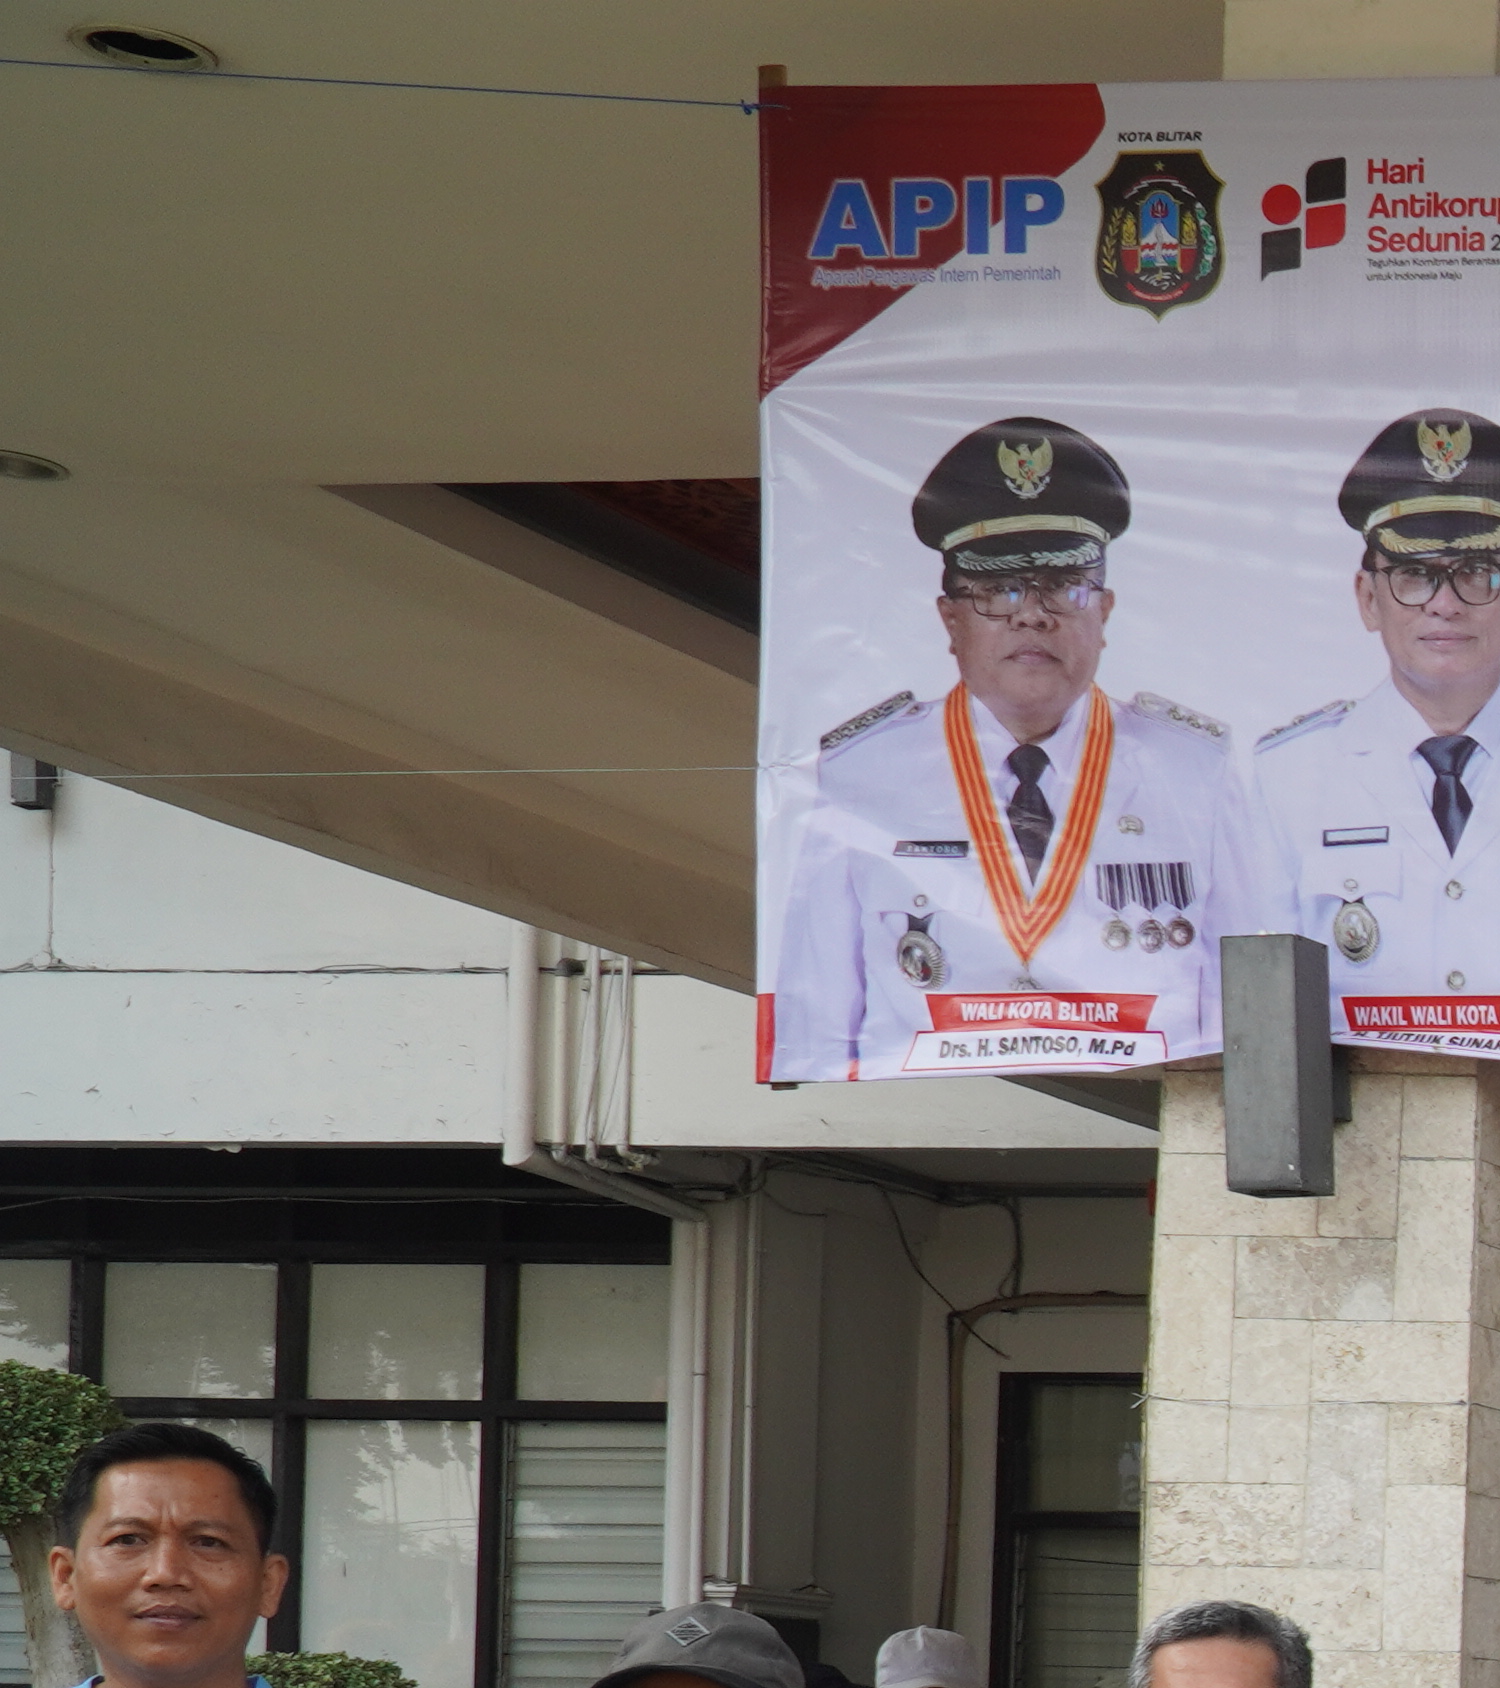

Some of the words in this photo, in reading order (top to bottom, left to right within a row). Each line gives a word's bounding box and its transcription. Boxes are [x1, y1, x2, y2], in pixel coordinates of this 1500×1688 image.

[1117, 131, 1152, 143] KOTA
[1156, 131, 1203, 142] BLITAR
[1367, 157, 1424, 184] Hari
[807, 176, 1066, 259] APIP
[1367, 225, 1486, 253] Sedunia
[812, 266, 861, 290] Aparat
[863, 266, 935, 290] Pengawas
[940, 267, 979, 283] Intern
[983, 265, 1062, 284] Pemerintah
[961, 1002, 1003, 1022] WALI
[1007, 1002, 1053, 1021] KOTA
[1057, 1002, 1119, 1022] BLITAR
[1354, 1006, 1407, 1026] WAKIL
[1411, 1005, 1451, 1026] WALI
[1456, 1004, 1499, 1025] KOTA
[939, 1040, 972, 1058] Drs.
[977, 1038, 993, 1057] H.
[998, 1035, 1082, 1056] SANTOSO,
[1088, 1038, 1136, 1057] M.Pd
